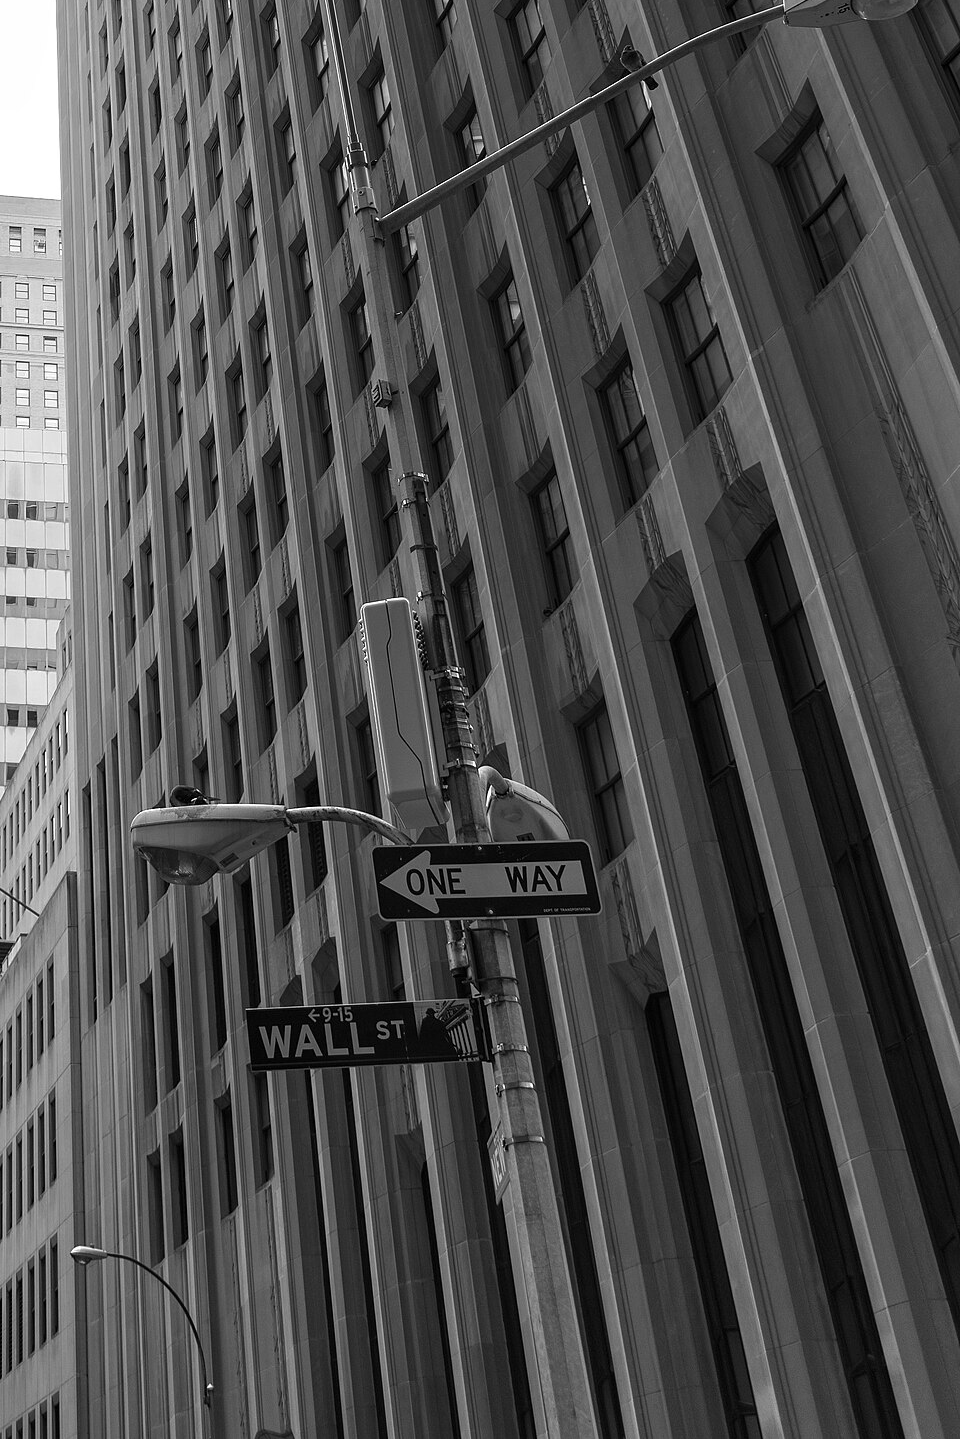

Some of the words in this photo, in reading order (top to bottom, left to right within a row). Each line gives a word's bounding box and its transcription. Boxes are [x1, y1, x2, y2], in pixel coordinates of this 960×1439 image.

[406, 867, 467, 895] ONE
[504, 864, 566, 893] WAY
[322, 1006, 354, 1023] 9-15
[258, 1022, 375, 1059] WALL
[375, 1019, 405, 1040] ST
